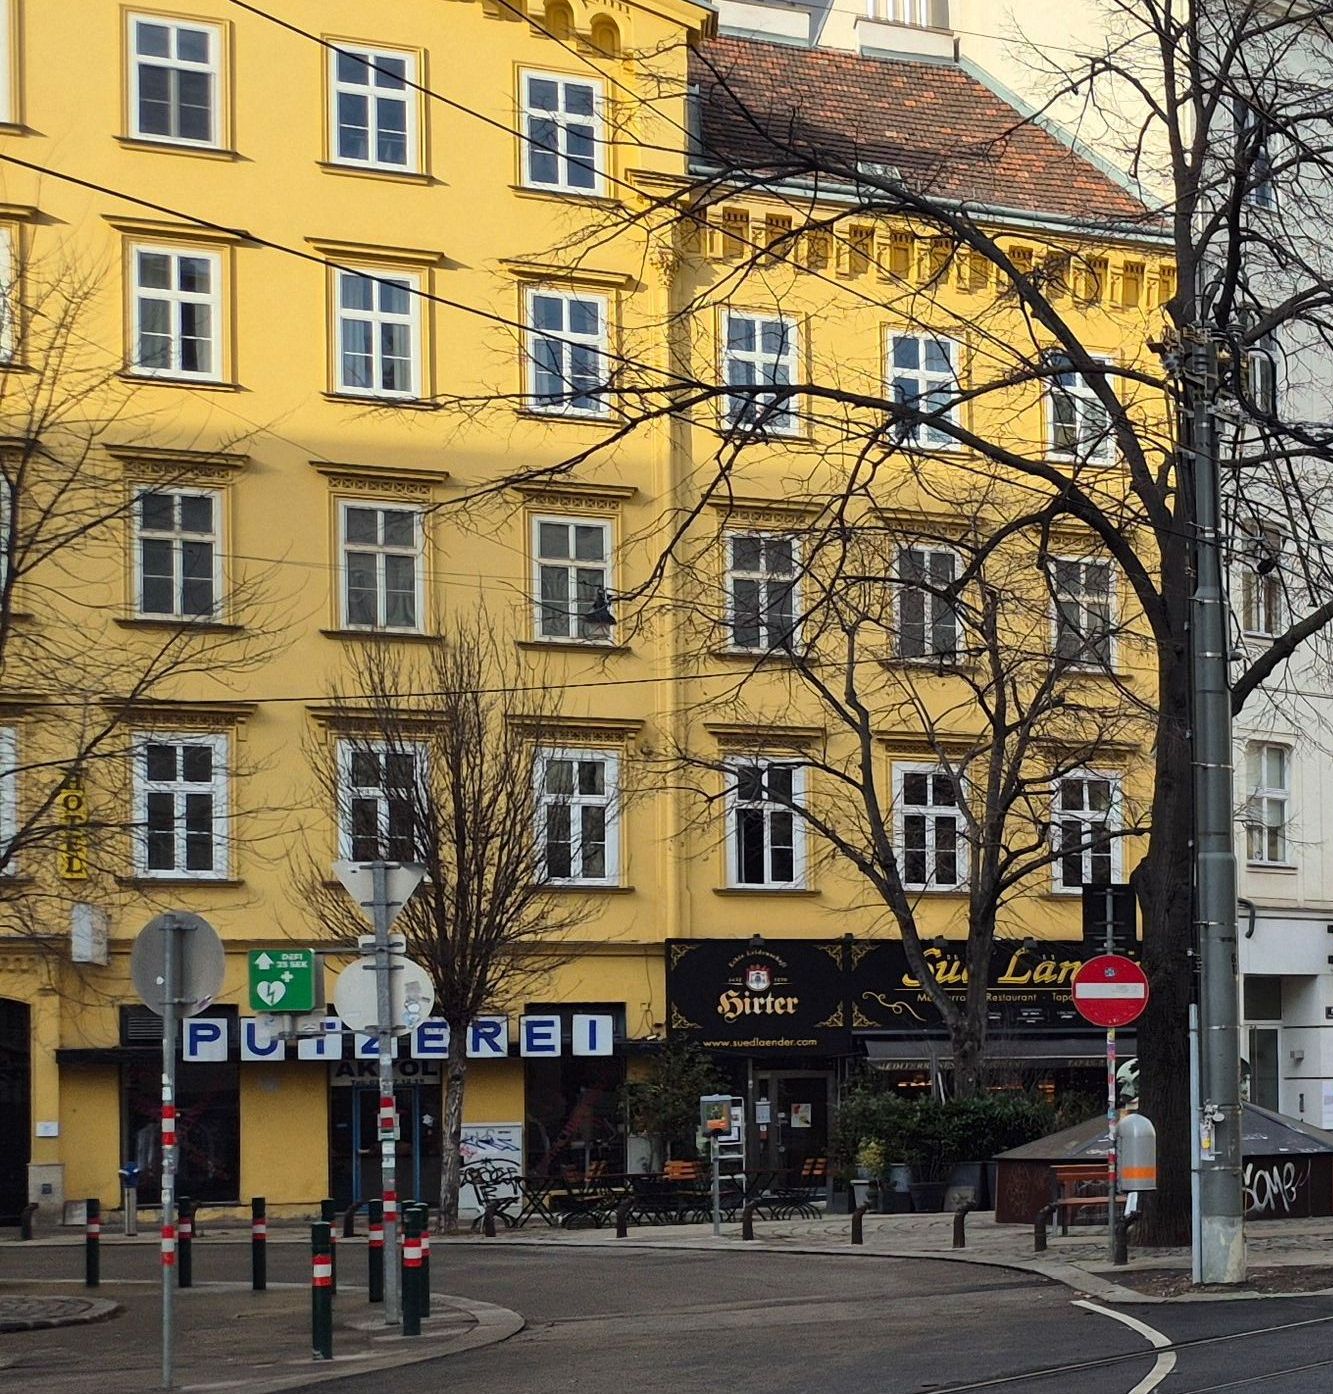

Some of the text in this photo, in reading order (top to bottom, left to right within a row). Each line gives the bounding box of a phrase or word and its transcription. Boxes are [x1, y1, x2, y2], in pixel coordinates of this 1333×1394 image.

[986, 992, 1037, 1002] Restaurant
[717, 989, 799, 1023] Hirter
[702, 1036, 818, 1048] www.suedlaender.com
[335, 1060, 438, 1077] AKOL
